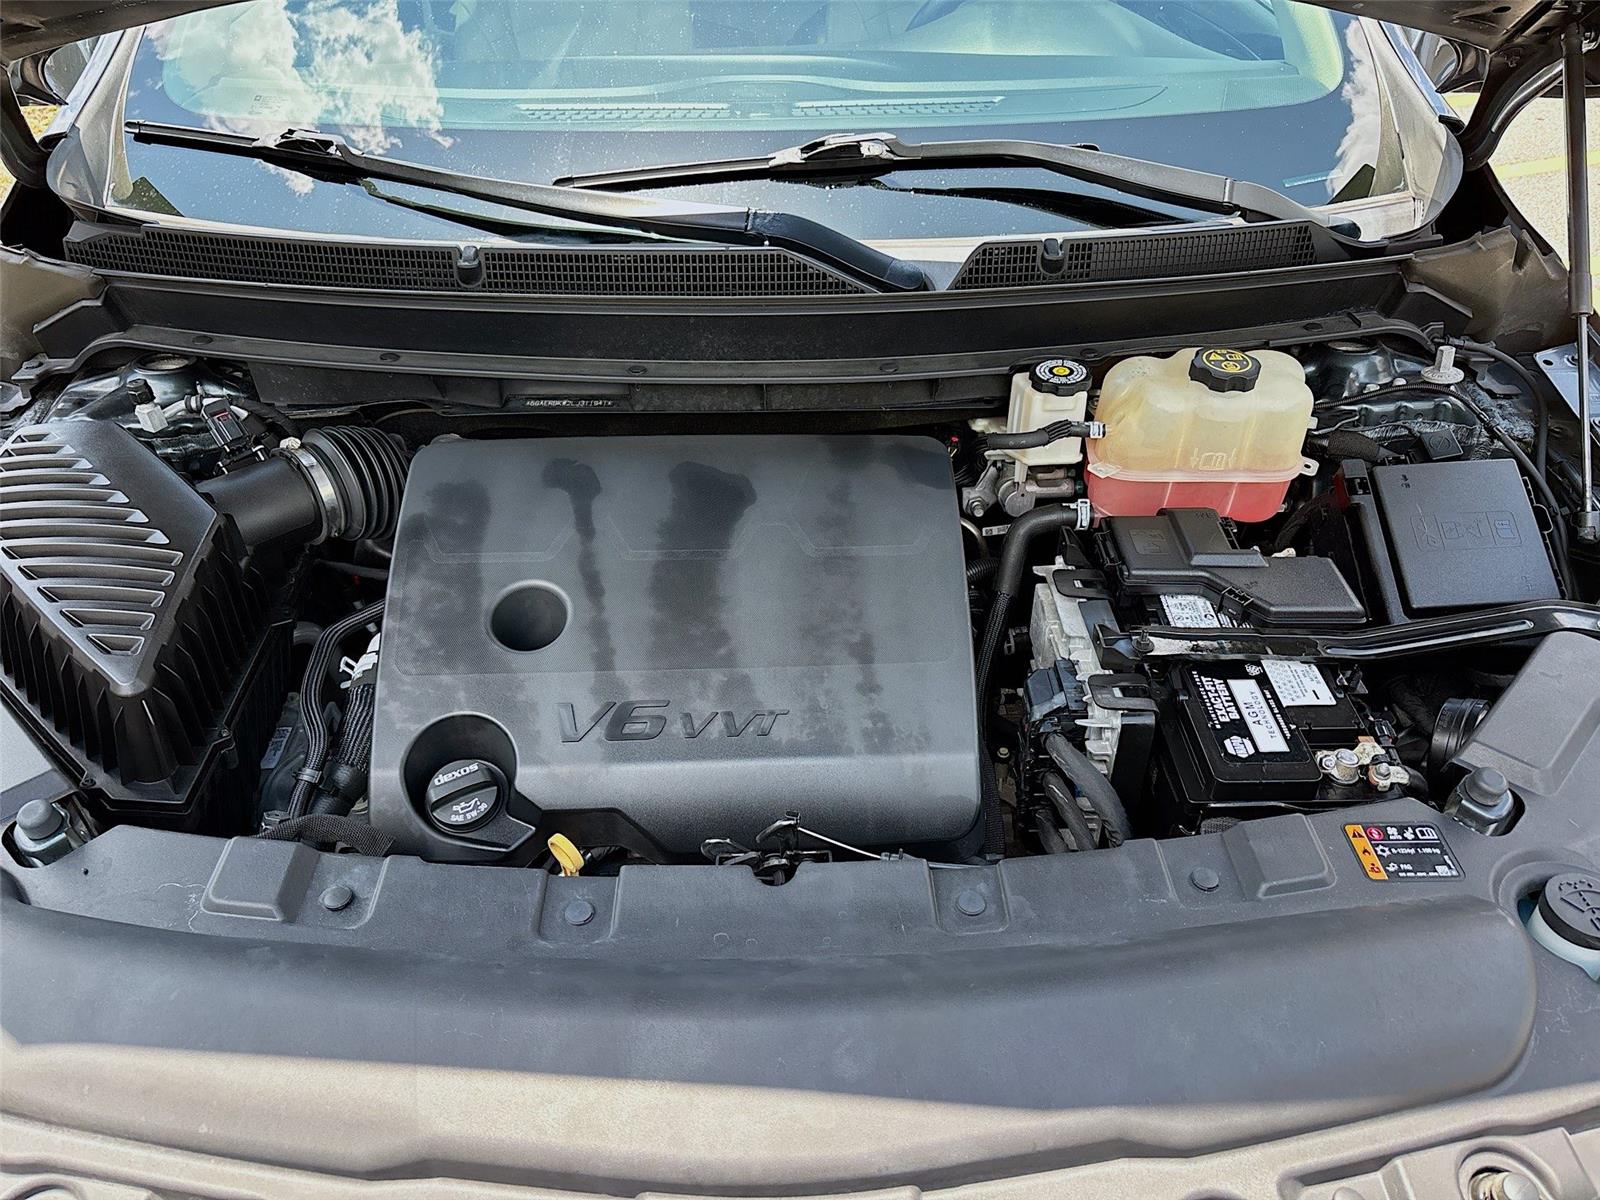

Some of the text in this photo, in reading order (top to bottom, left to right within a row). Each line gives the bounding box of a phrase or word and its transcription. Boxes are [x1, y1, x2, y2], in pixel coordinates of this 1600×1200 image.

[1201, 676, 1231, 723] EXACT-FIT
[1212, 678, 1240, 720] BATTERY
[1243, 702, 1264, 726] AGM
[1249, 690, 1277, 739] TECHNOLOGY
[555, 700, 790, 743] V6 VVT
[434, 763, 479, 786] dexos
